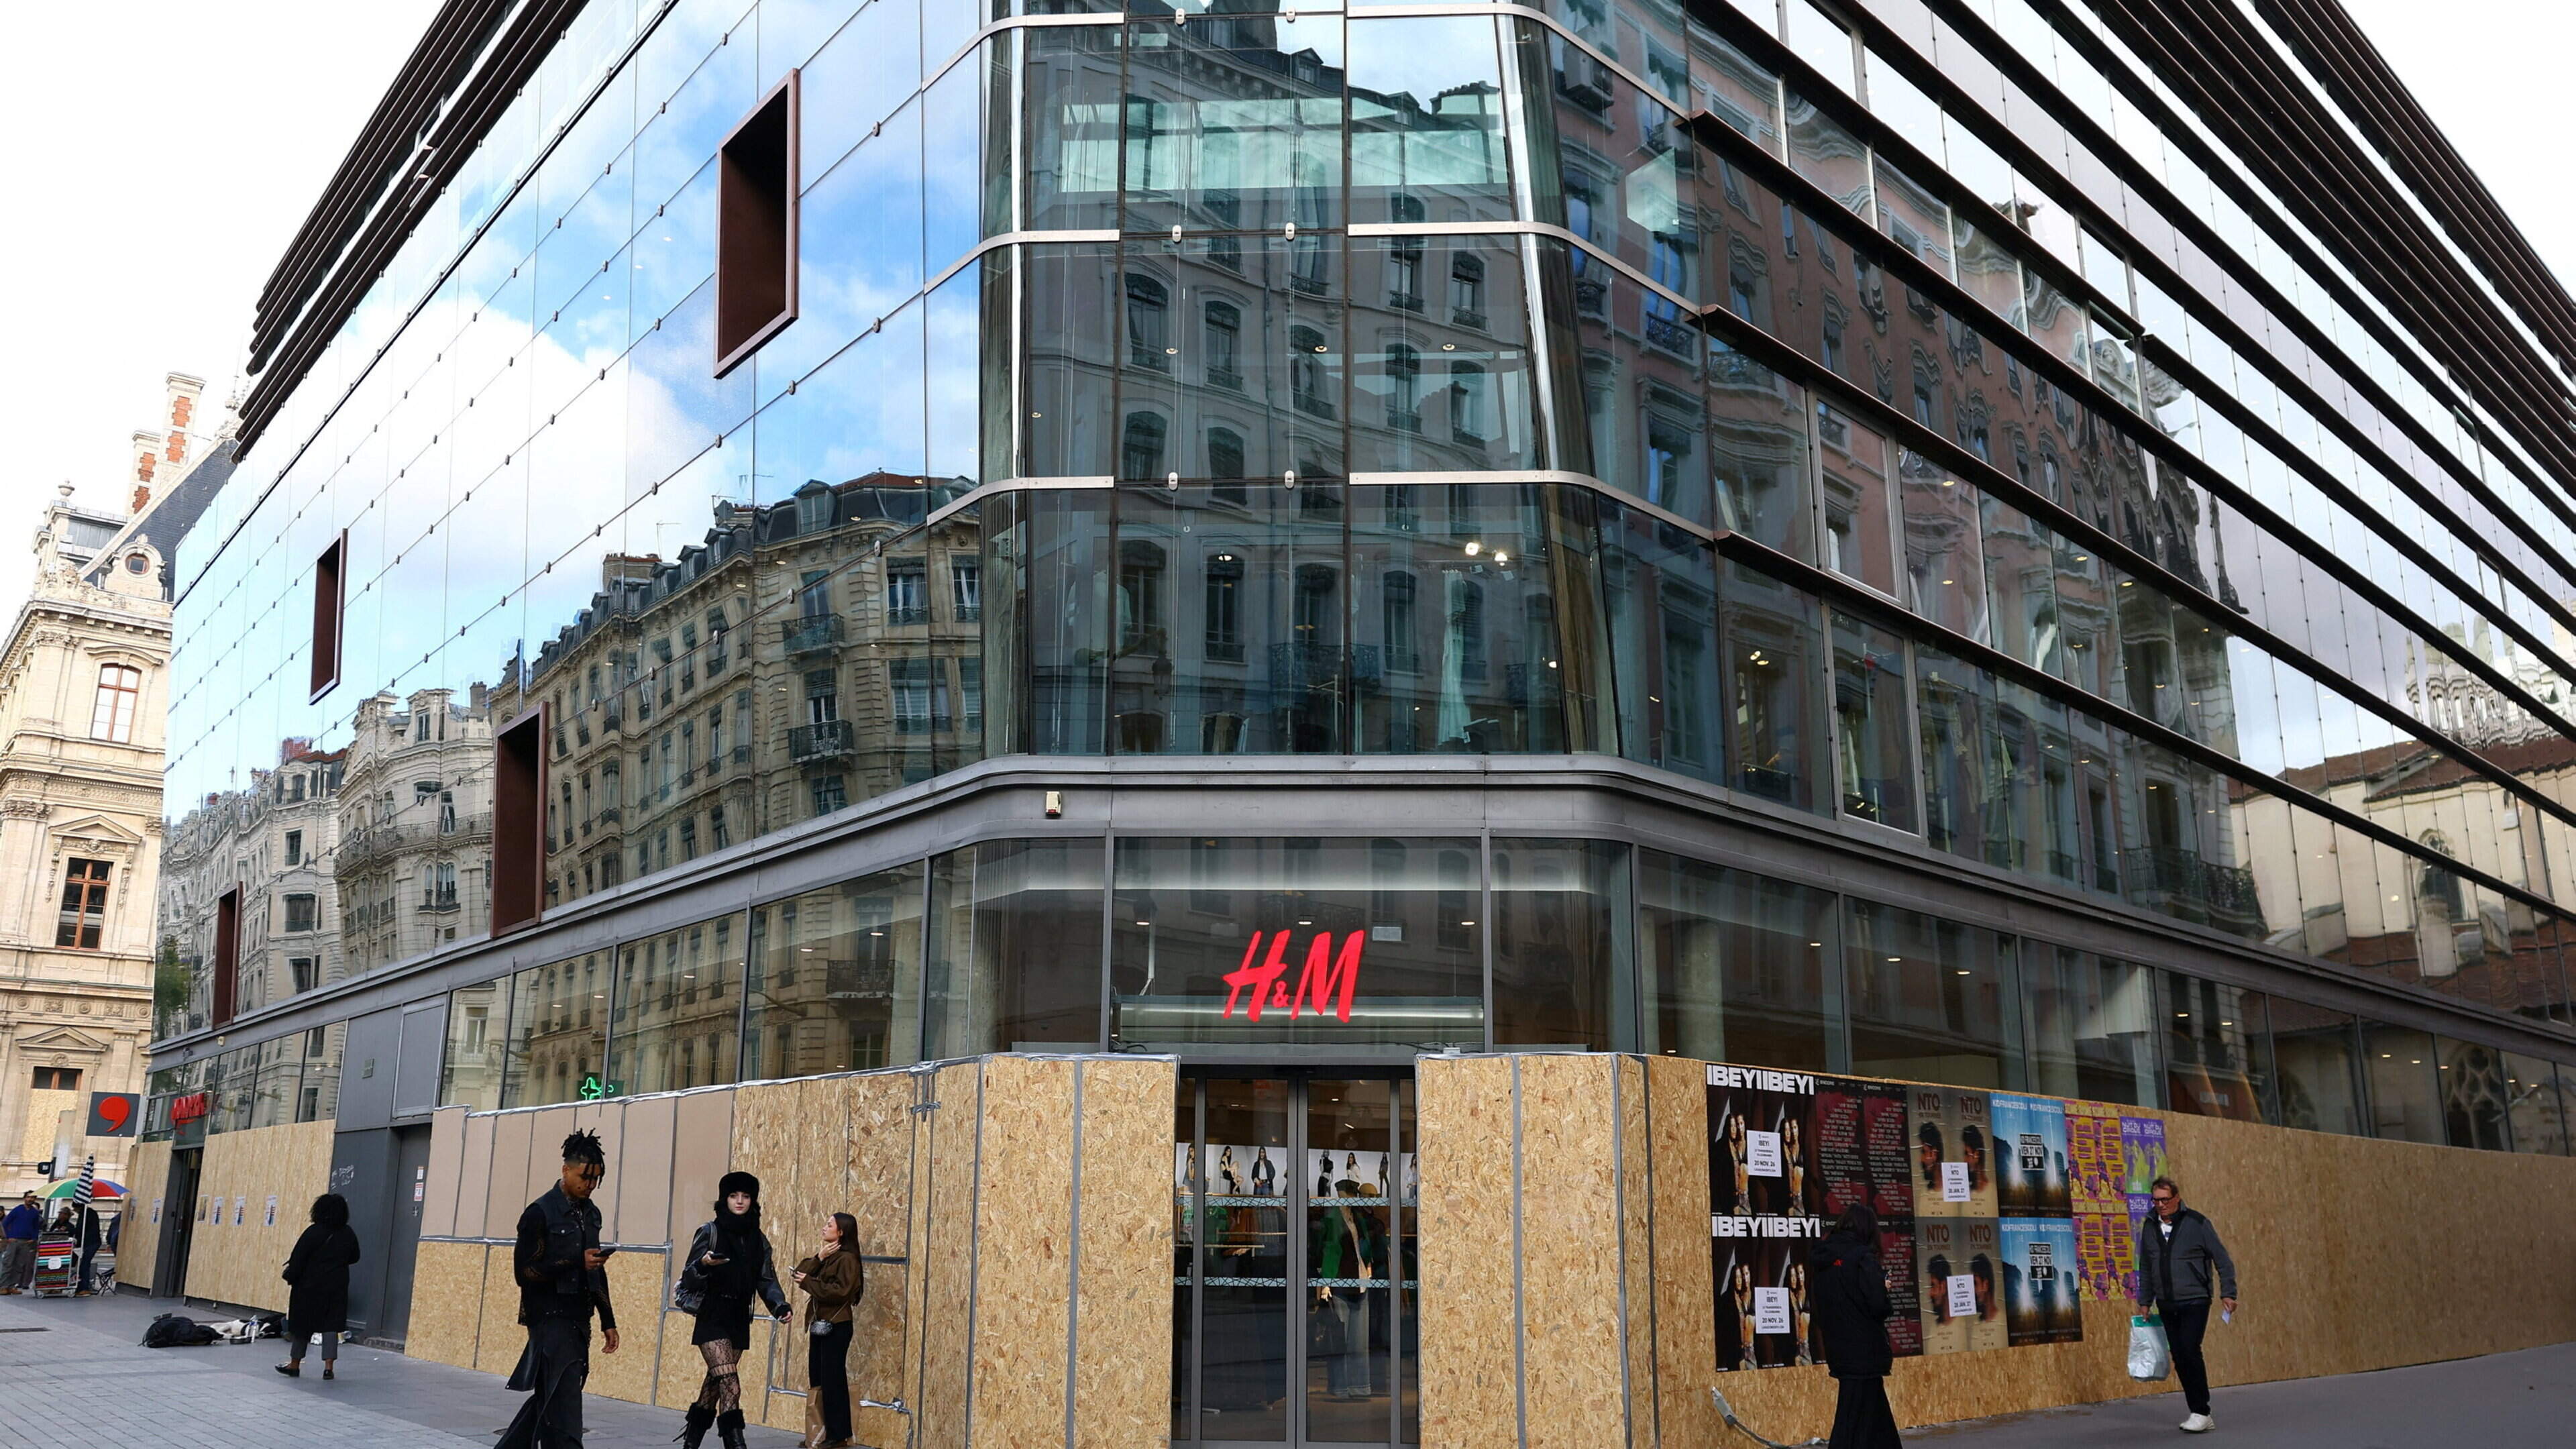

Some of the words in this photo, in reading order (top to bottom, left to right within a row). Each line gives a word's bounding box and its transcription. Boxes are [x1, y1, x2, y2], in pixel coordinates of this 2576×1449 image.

[1222, 929, 1365, 1023] H&M
[1706, 1064, 1762, 1089] IBEYI
[1762, 1071, 1815, 1095] IBEYI
[1917, 1092, 1941, 1111] NTO
[1960, 1095, 1982, 1114] NTO
[2029, 1146, 2034, 1155] 27
[1711, 1216, 1768, 1238] IBEYI
[1768, 1216, 1821, 1238] IBEYI
[1926, 1224, 1949, 1242] NTO
[1969, 1224, 1992, 1242] NTO
[2039, 1255, 2043, 1265] 27
